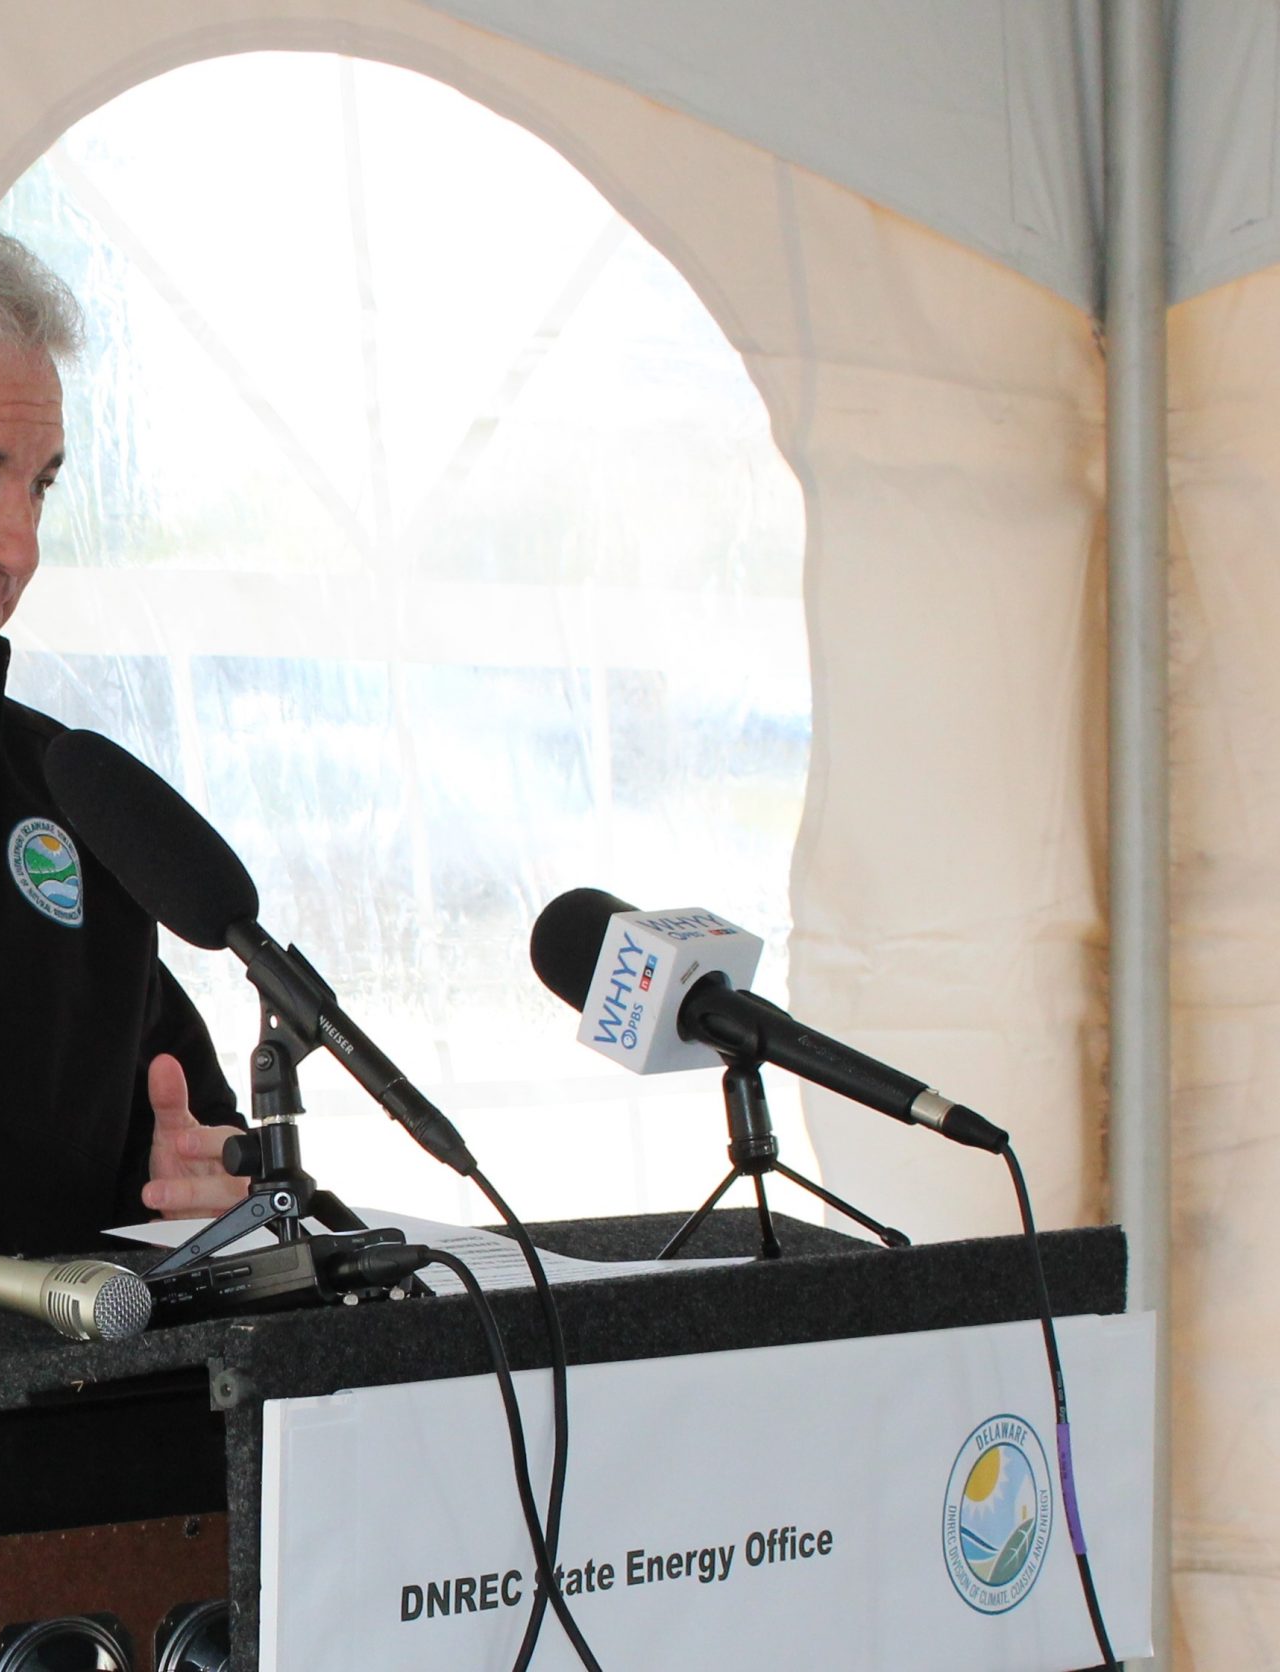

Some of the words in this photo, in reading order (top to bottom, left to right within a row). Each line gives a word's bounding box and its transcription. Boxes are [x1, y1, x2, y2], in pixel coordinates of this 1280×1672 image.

[635, 914, 724, 932] WHYY
[594, 932, 644, 1044] WHYY
[640, 955, 658, 991] npr
[628, 1003, 644, 1030] PBS
[975, 1422, 1028, 1451] DELAWARE
[946, 1504, 957, 1545] DNREC
[1039, 1489, 1049, 1534] ENERGY
[1033, 1536, 1046, 1562] AND
[400, 1568, 523, 1622] DNREC
[625, 1545, 735, 1584] Energy
[745, 1526, 834, 1566] Office
[948, 1546, 971, 1592] DIVISION
[1010, 1562, 1036, 1600] COASTAL
[970, 1584, 980, 1601] OF
